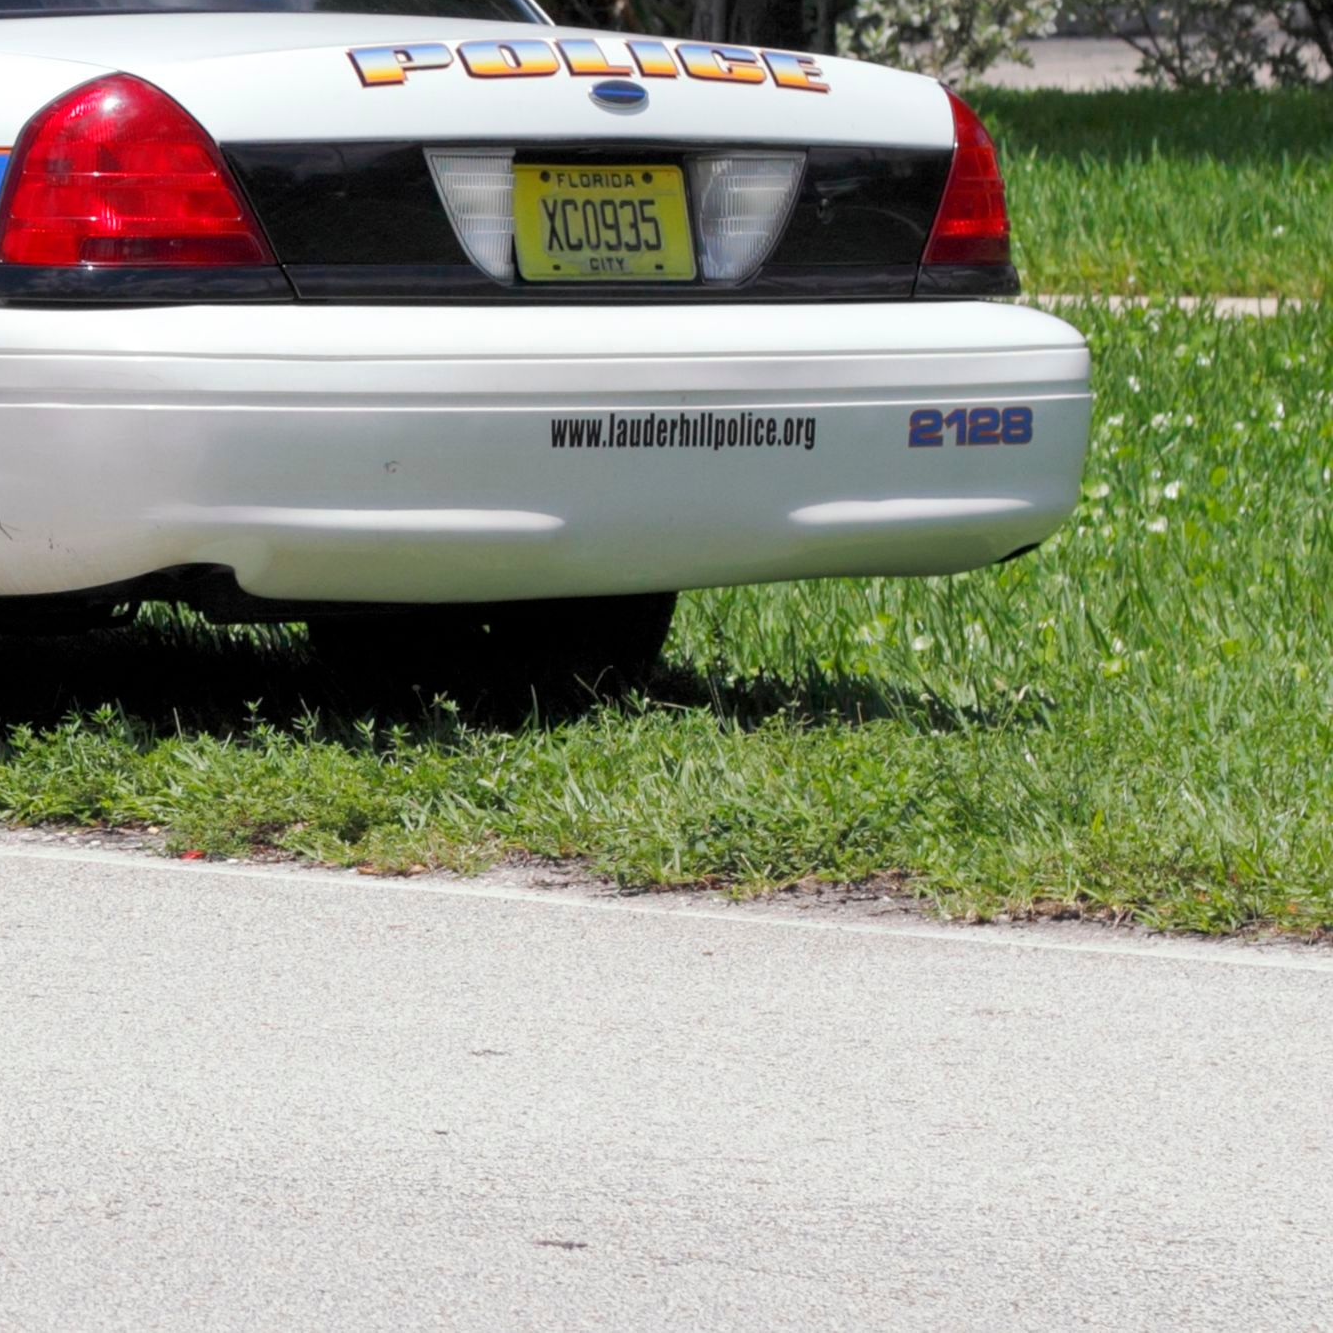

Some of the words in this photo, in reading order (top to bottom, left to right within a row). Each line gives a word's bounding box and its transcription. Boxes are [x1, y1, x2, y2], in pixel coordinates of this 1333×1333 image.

[346, 38, 831, 93] POLICE
[556, 173, 636, 188] FLORIDA
[542, 198, 662, 252] XC0935
[590, 257, 625, 271] CITY
[551, 412, 816, 451] www.lauderhillpolice.org
[908, 406, 1034, 448] 2128
